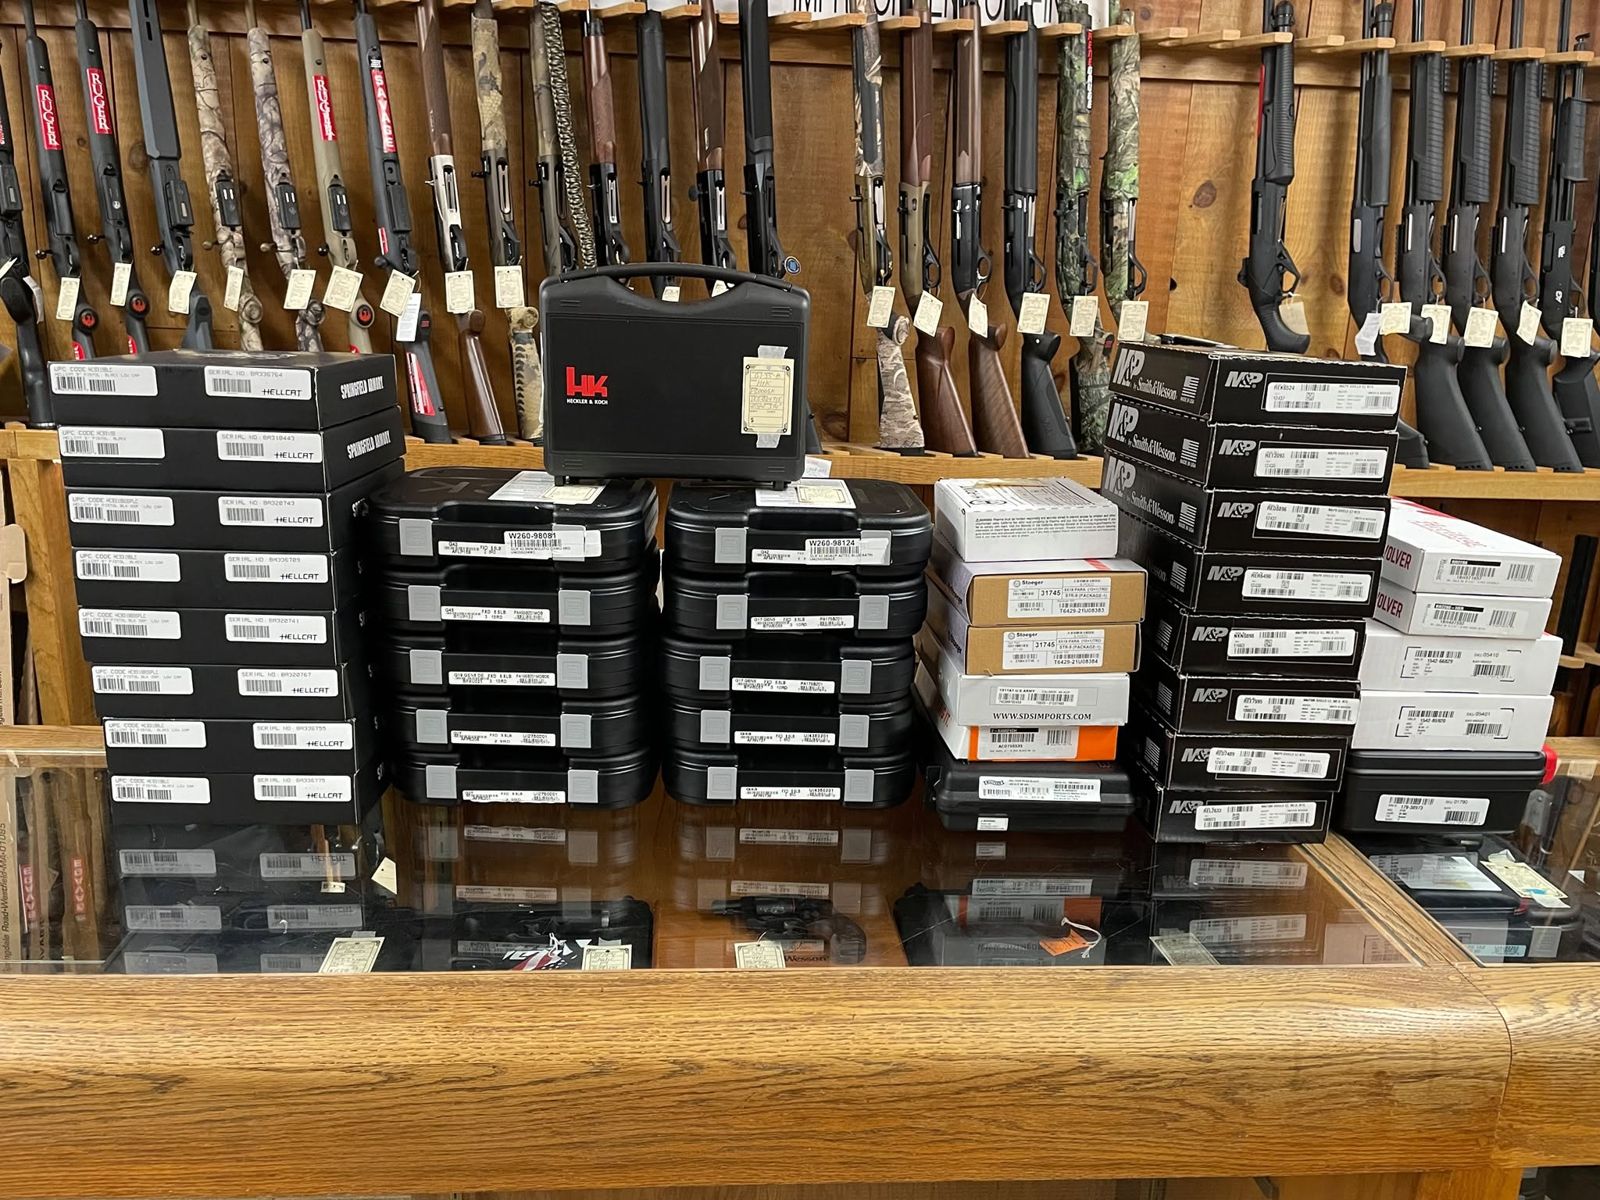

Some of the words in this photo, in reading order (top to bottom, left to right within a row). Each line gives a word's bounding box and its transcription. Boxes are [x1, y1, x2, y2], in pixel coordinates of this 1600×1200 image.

[91, 73, 110, 130] RUGER
[317, 79, 335, 137] RUGER
[40, 89, 60, 146] RUGER
[374, 75, 394, 147] SAVAGE
[1112, 348, 1145, 388] M&P
[566, 366, 608, 398] HK
[1225, 371, 1264, 388] M&P
[261, 388, 302, 397] HELLCAT
[1107, 402, 1139, 442] M&P
[274, 451, 314, 460] HELLCAT
[1218, 439, 1257, 456] M&P
[1104, 456, 1136, 497] M&P
[1217, 502, 1255, 518] M&P
[274, 516, 314, 524] HELLCAT
[508, 532, 557, 540] W260-98081
[809, 539, 856, 547] W260-98124
[280, 573, 320, 581] HELLCAT
[1207, 565, 1244, 581] M&P
[279, 633, 318, 641] HELLCAT
[1192, 626, 1229, 642] M&P
[1192, 687, 1228, 703] M&P
[992, 712, 1092, 721] WWW.SDSIMPORTS.COM
[306, 740, 345, 748] HELLCAT
